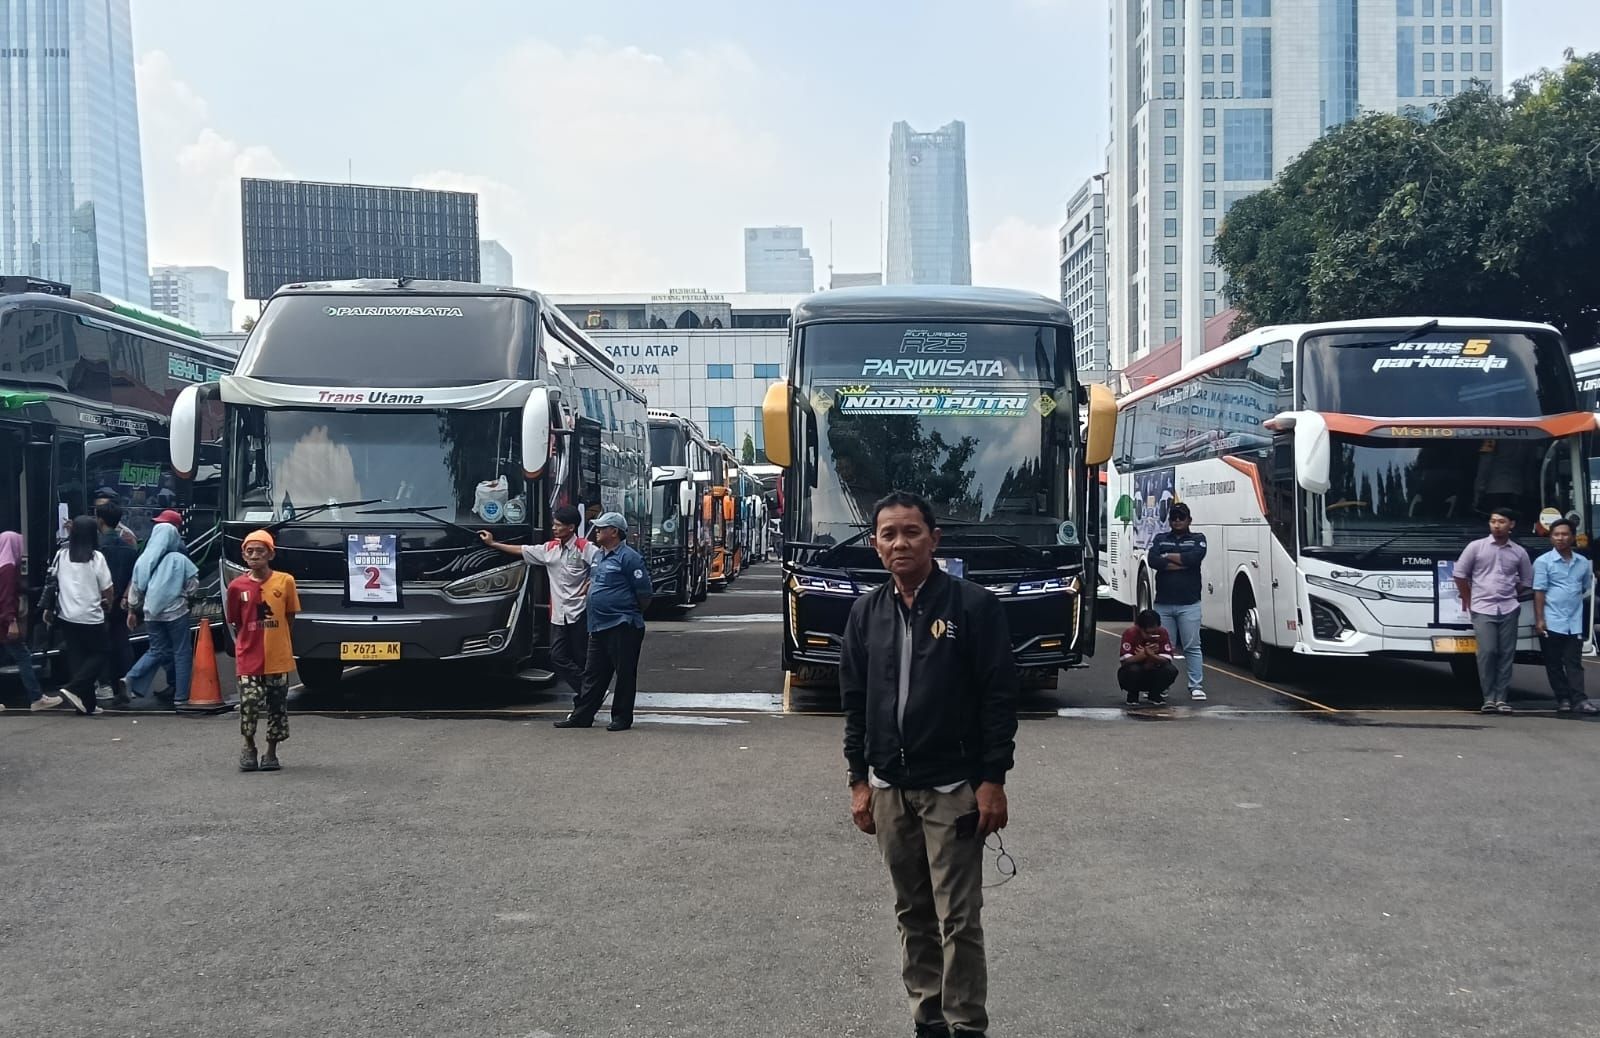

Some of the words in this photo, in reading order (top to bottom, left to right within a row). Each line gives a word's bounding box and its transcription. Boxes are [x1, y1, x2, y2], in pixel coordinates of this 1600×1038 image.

[337, 306, 464, 317] PARIWISATA
[604, 345, 640, 357] SATU
[645, 345, 679, 357] ATAP
[1390, 342, 1464, 351] JETBUS
[1462, 339, 1491, 355] 5
[630, 364, 660, 375] JAYA
[861, 358, 1005, 380] PARIWISATA
[1372, 354, 1508, 373] pariwisata
[318, 391, 364, 403] Trans
[368, 392, 425, 404] Utama
[844, 396, 938, 409] NDORO
[942, 397, 1028, 409] PUTRI
[355, 556, 390, 565] WONOGIRI
[364, 567, 381, 589] 2
[342, 644, 349, 654] D
[353, 644, 376, 654] 7671
[386, 644, 399, 654] AK
